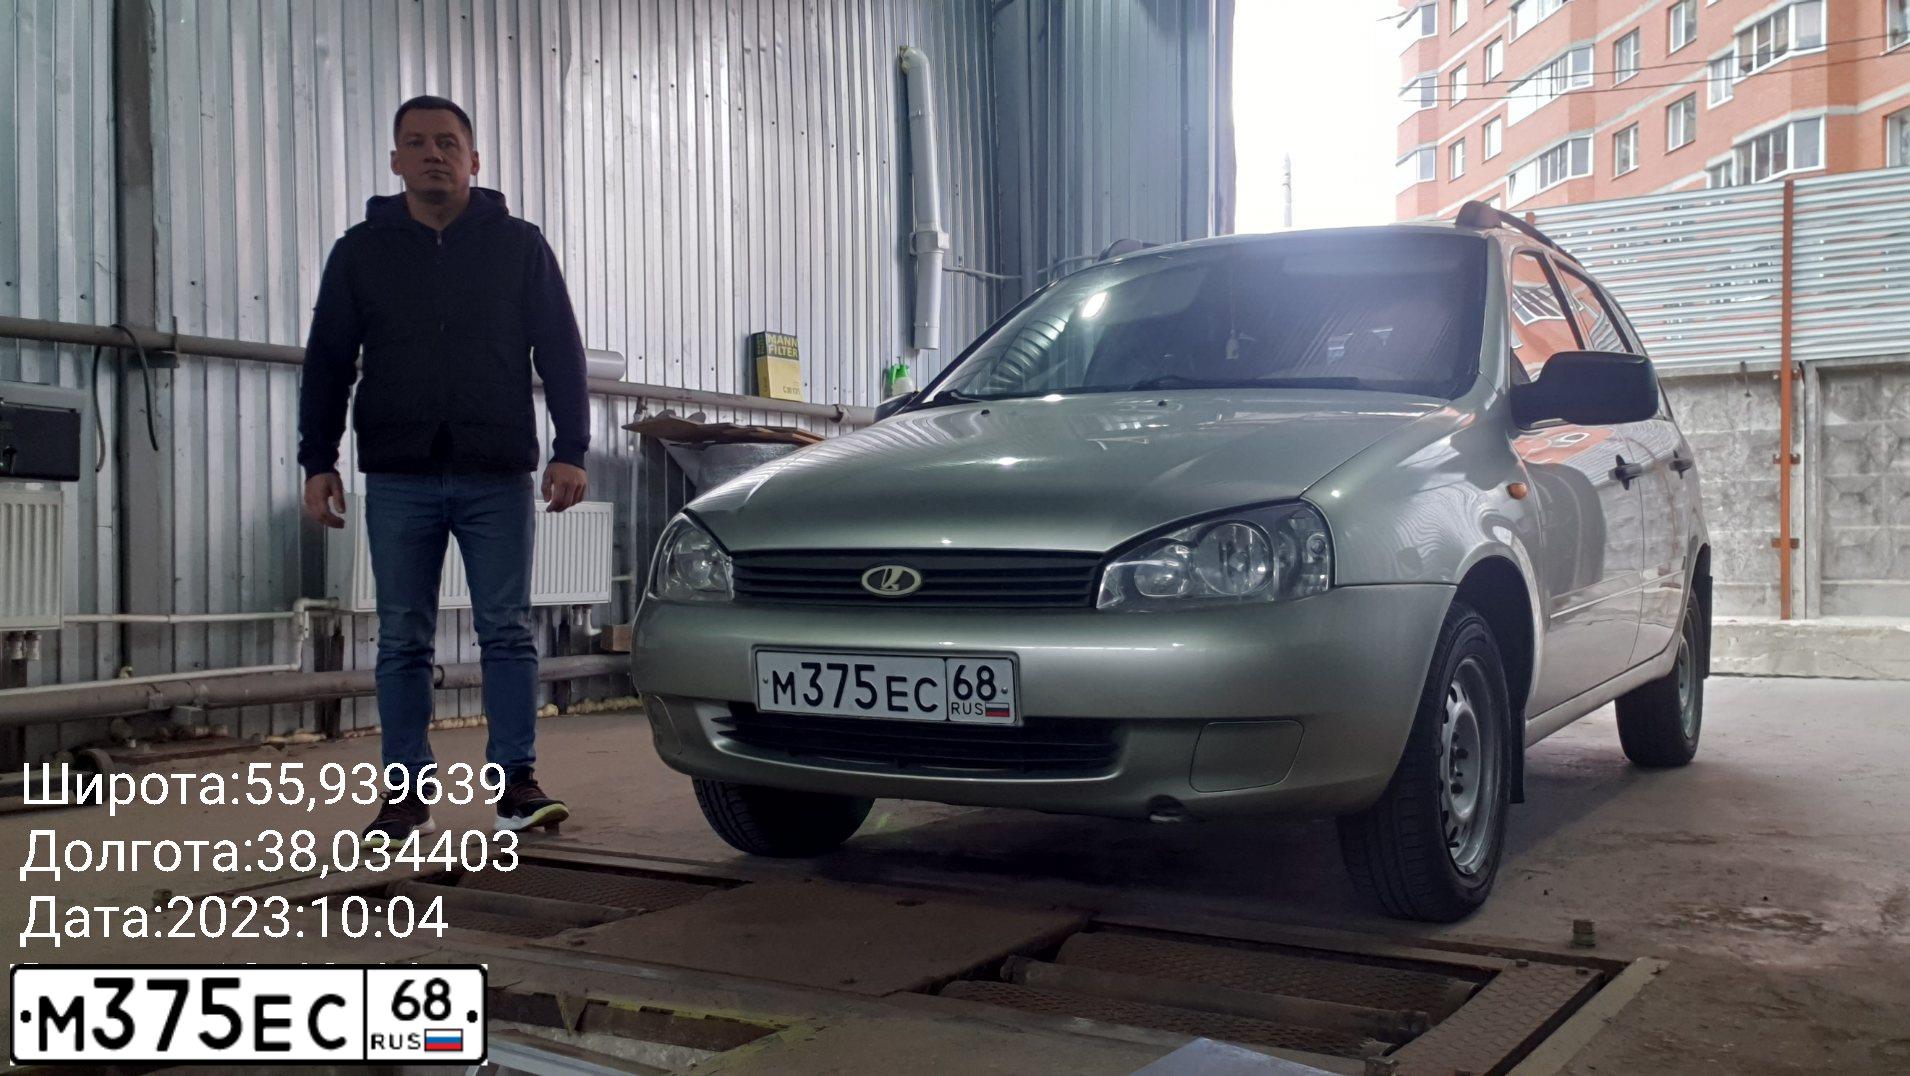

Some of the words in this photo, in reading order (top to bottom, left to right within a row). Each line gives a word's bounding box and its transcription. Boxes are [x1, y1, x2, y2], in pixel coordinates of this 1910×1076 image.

[767, 333, 799, 347] MANN
[768, 345, 799, 358] FILTER
[953, 664, 997, 701] 68
[950, 701, 984, 716] RUS
